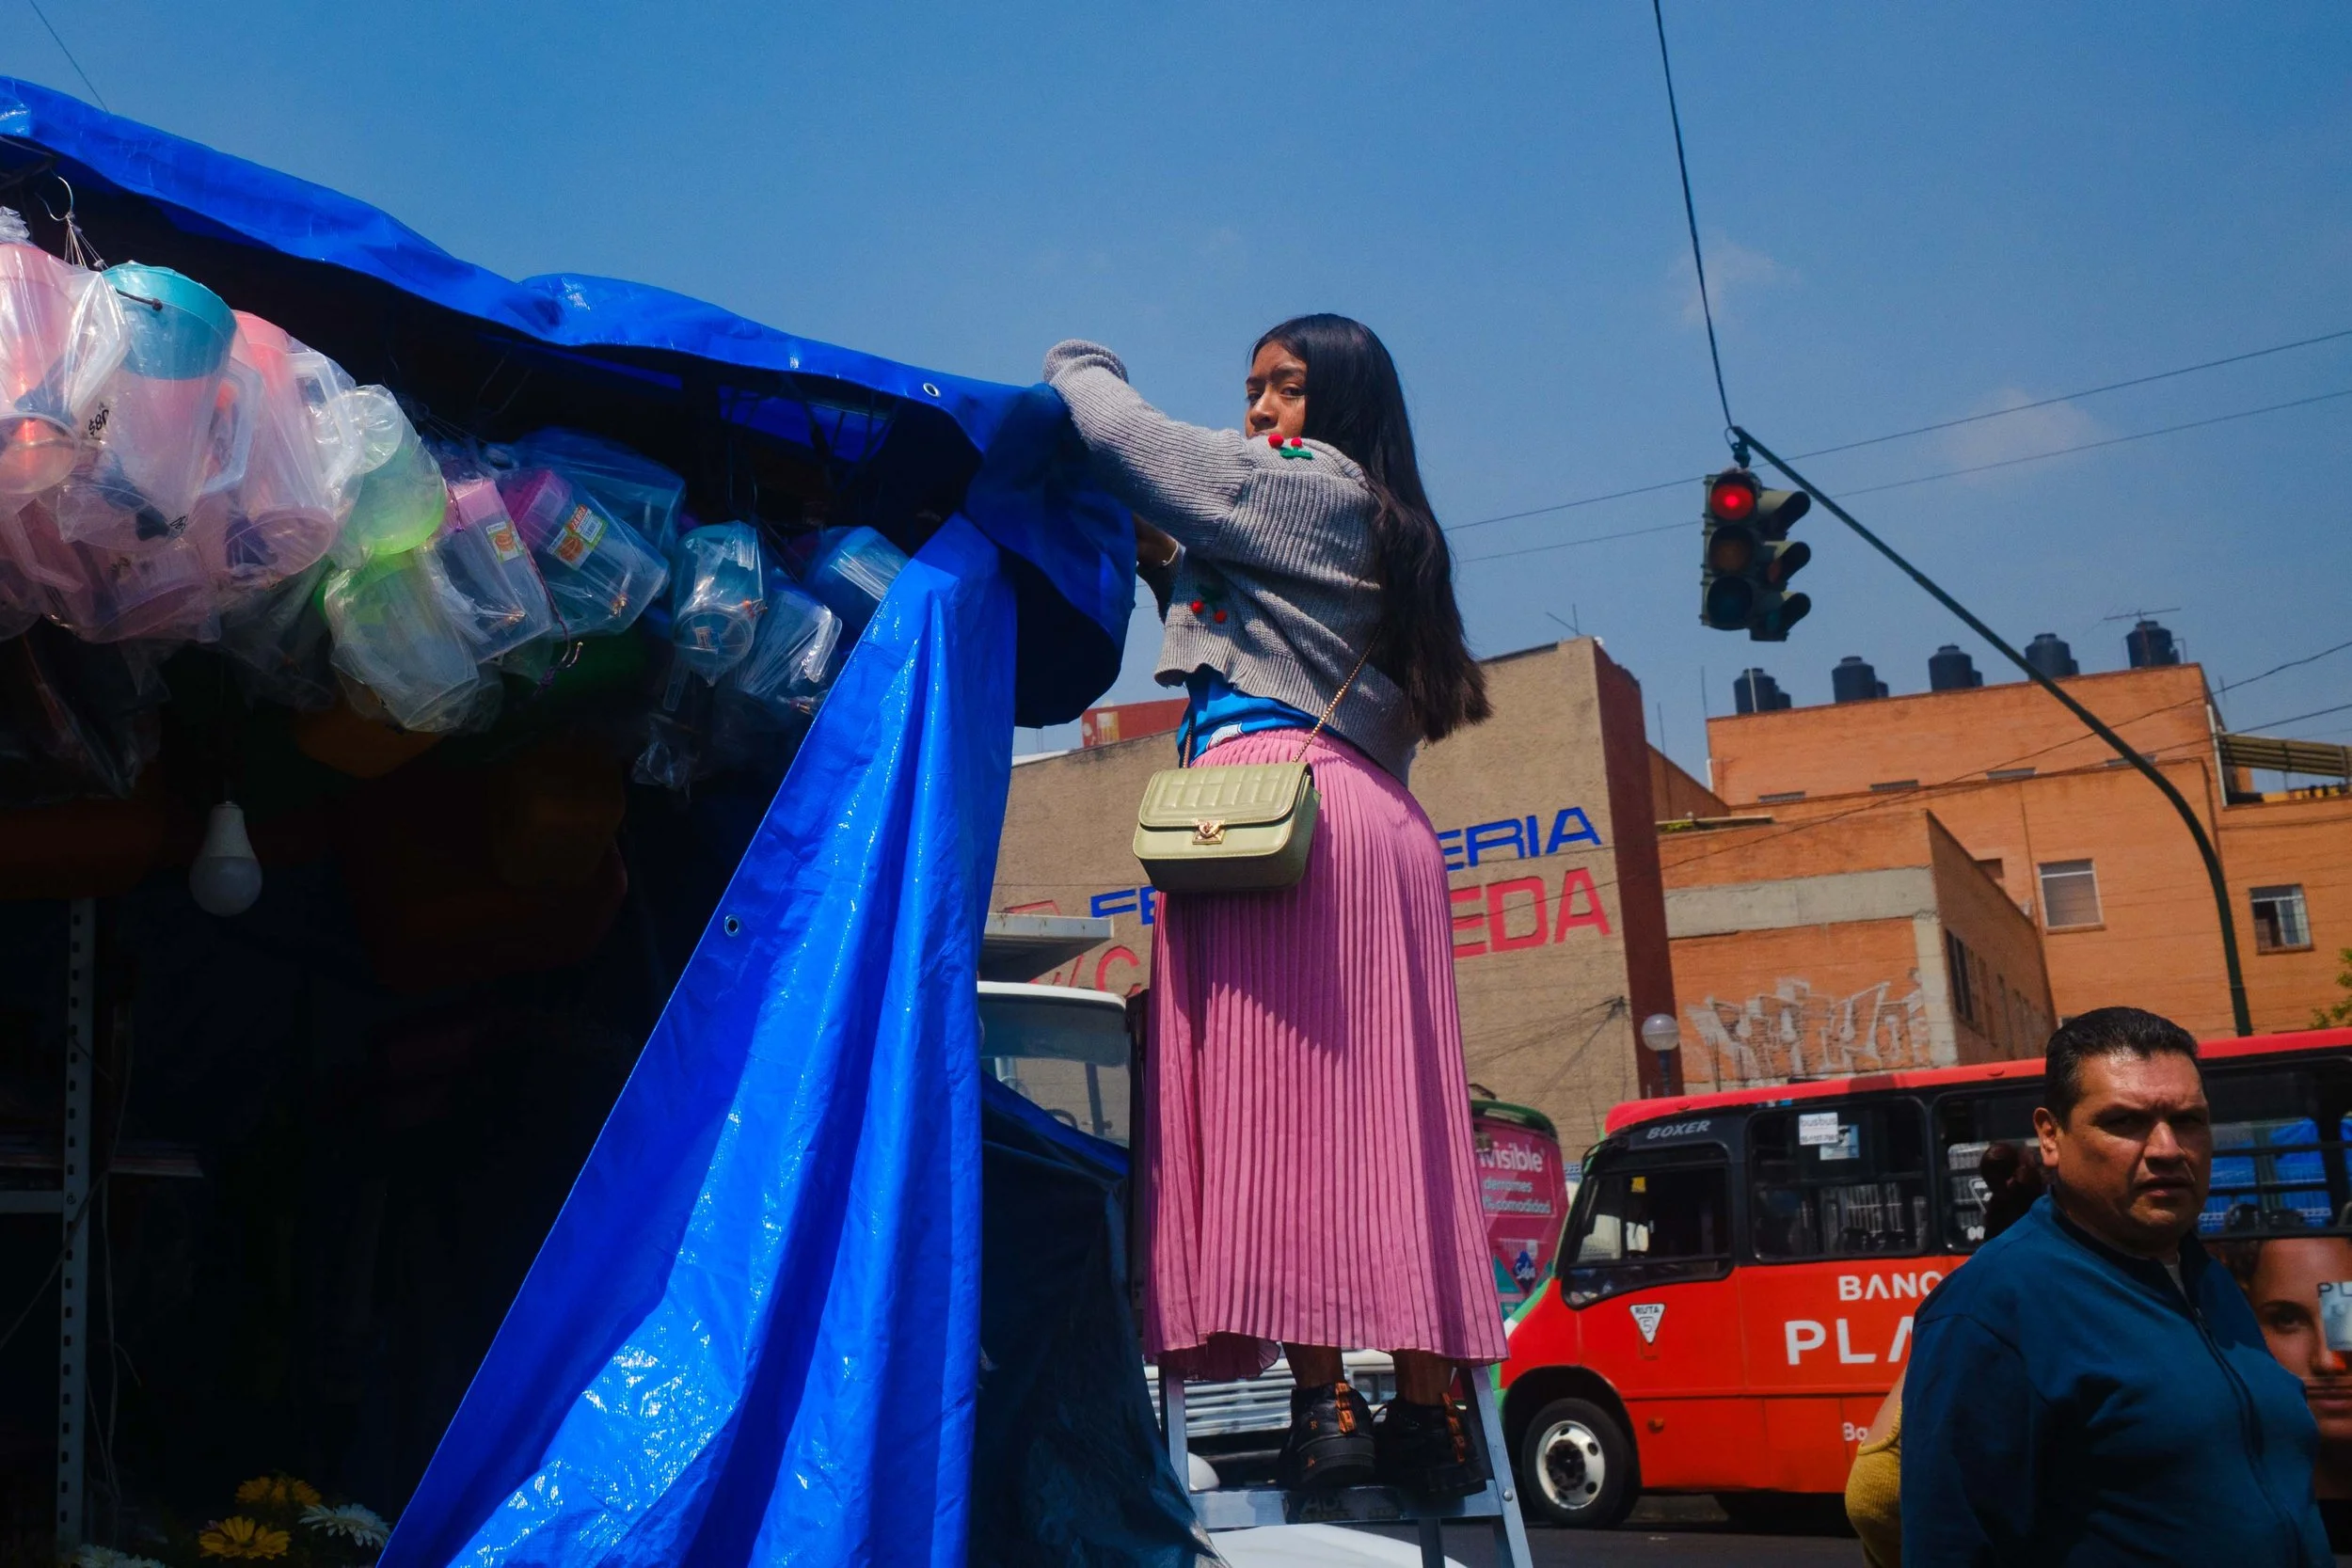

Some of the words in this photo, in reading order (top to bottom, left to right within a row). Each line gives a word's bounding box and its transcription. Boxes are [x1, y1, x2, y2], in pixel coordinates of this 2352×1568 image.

[1646, 1119, 1711, 1140] BOXER
[1635, 1306, 1661, 1315] RUTA
[1643, 1319, 1653, 1334] 5
